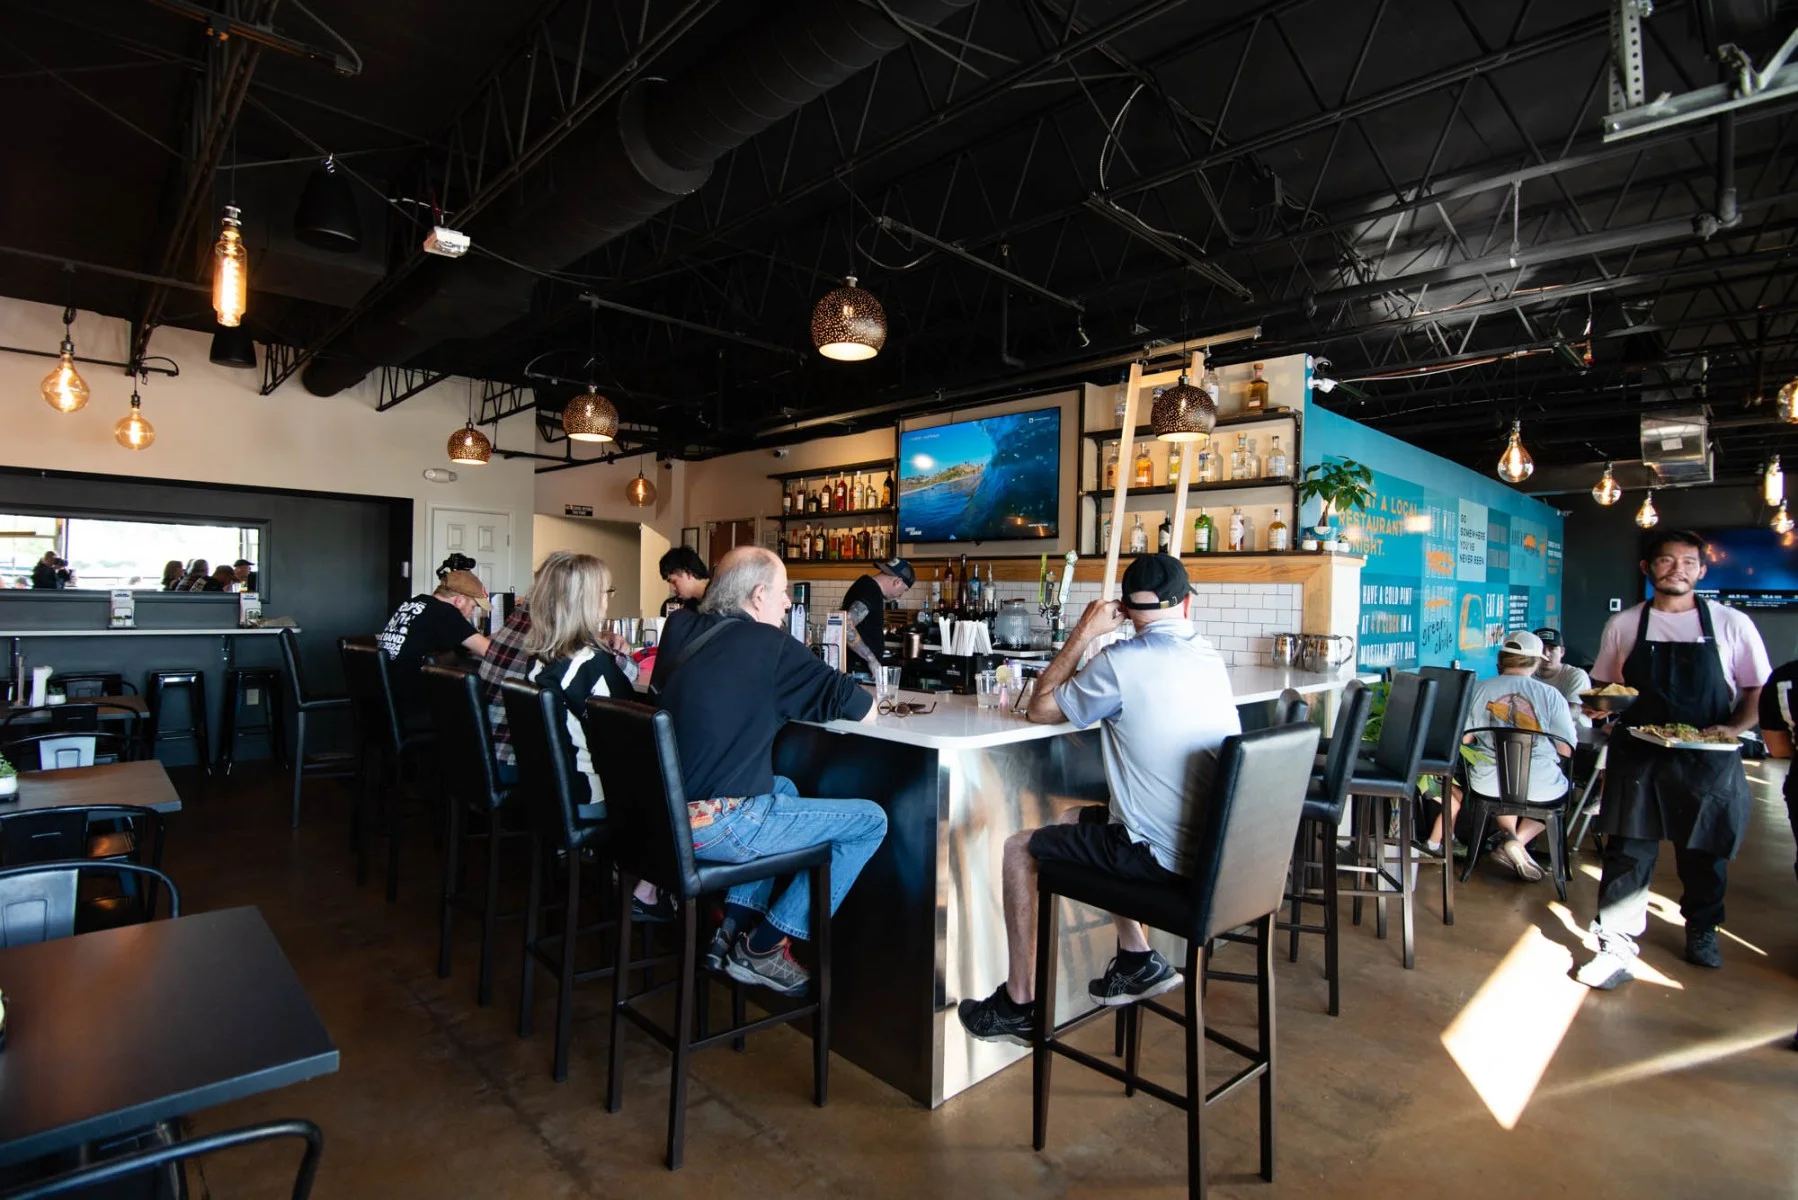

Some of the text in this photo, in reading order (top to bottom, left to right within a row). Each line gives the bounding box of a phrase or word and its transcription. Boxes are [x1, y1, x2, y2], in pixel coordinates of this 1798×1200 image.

[1380, 495, 1387, 512] A
[1391, 497, 1419, 518] LOCAL
[1338, 507, 1405, 537] RESTAURANT
[1460, 513, 1467, 524] GO
[1460, 527, 1486, 541] SOMEWHERE
[1460, 553, 1473, 564] NEVER
[1362, 585, 1377, 605] HAVE
[1378, 585, 1384, 605] A
[1385, 585, 1399, 605] COLD
[1400, 587, 1413, 606] PINT
[1485, 593, 1496, 618] EAT
[1361, 614, 1369, 635] AT
[1423, 617, 1446, 647] green
[1360, 644, 1384, 665] MOSTLY
[1385, 642, 1404, 661] EMPTY
